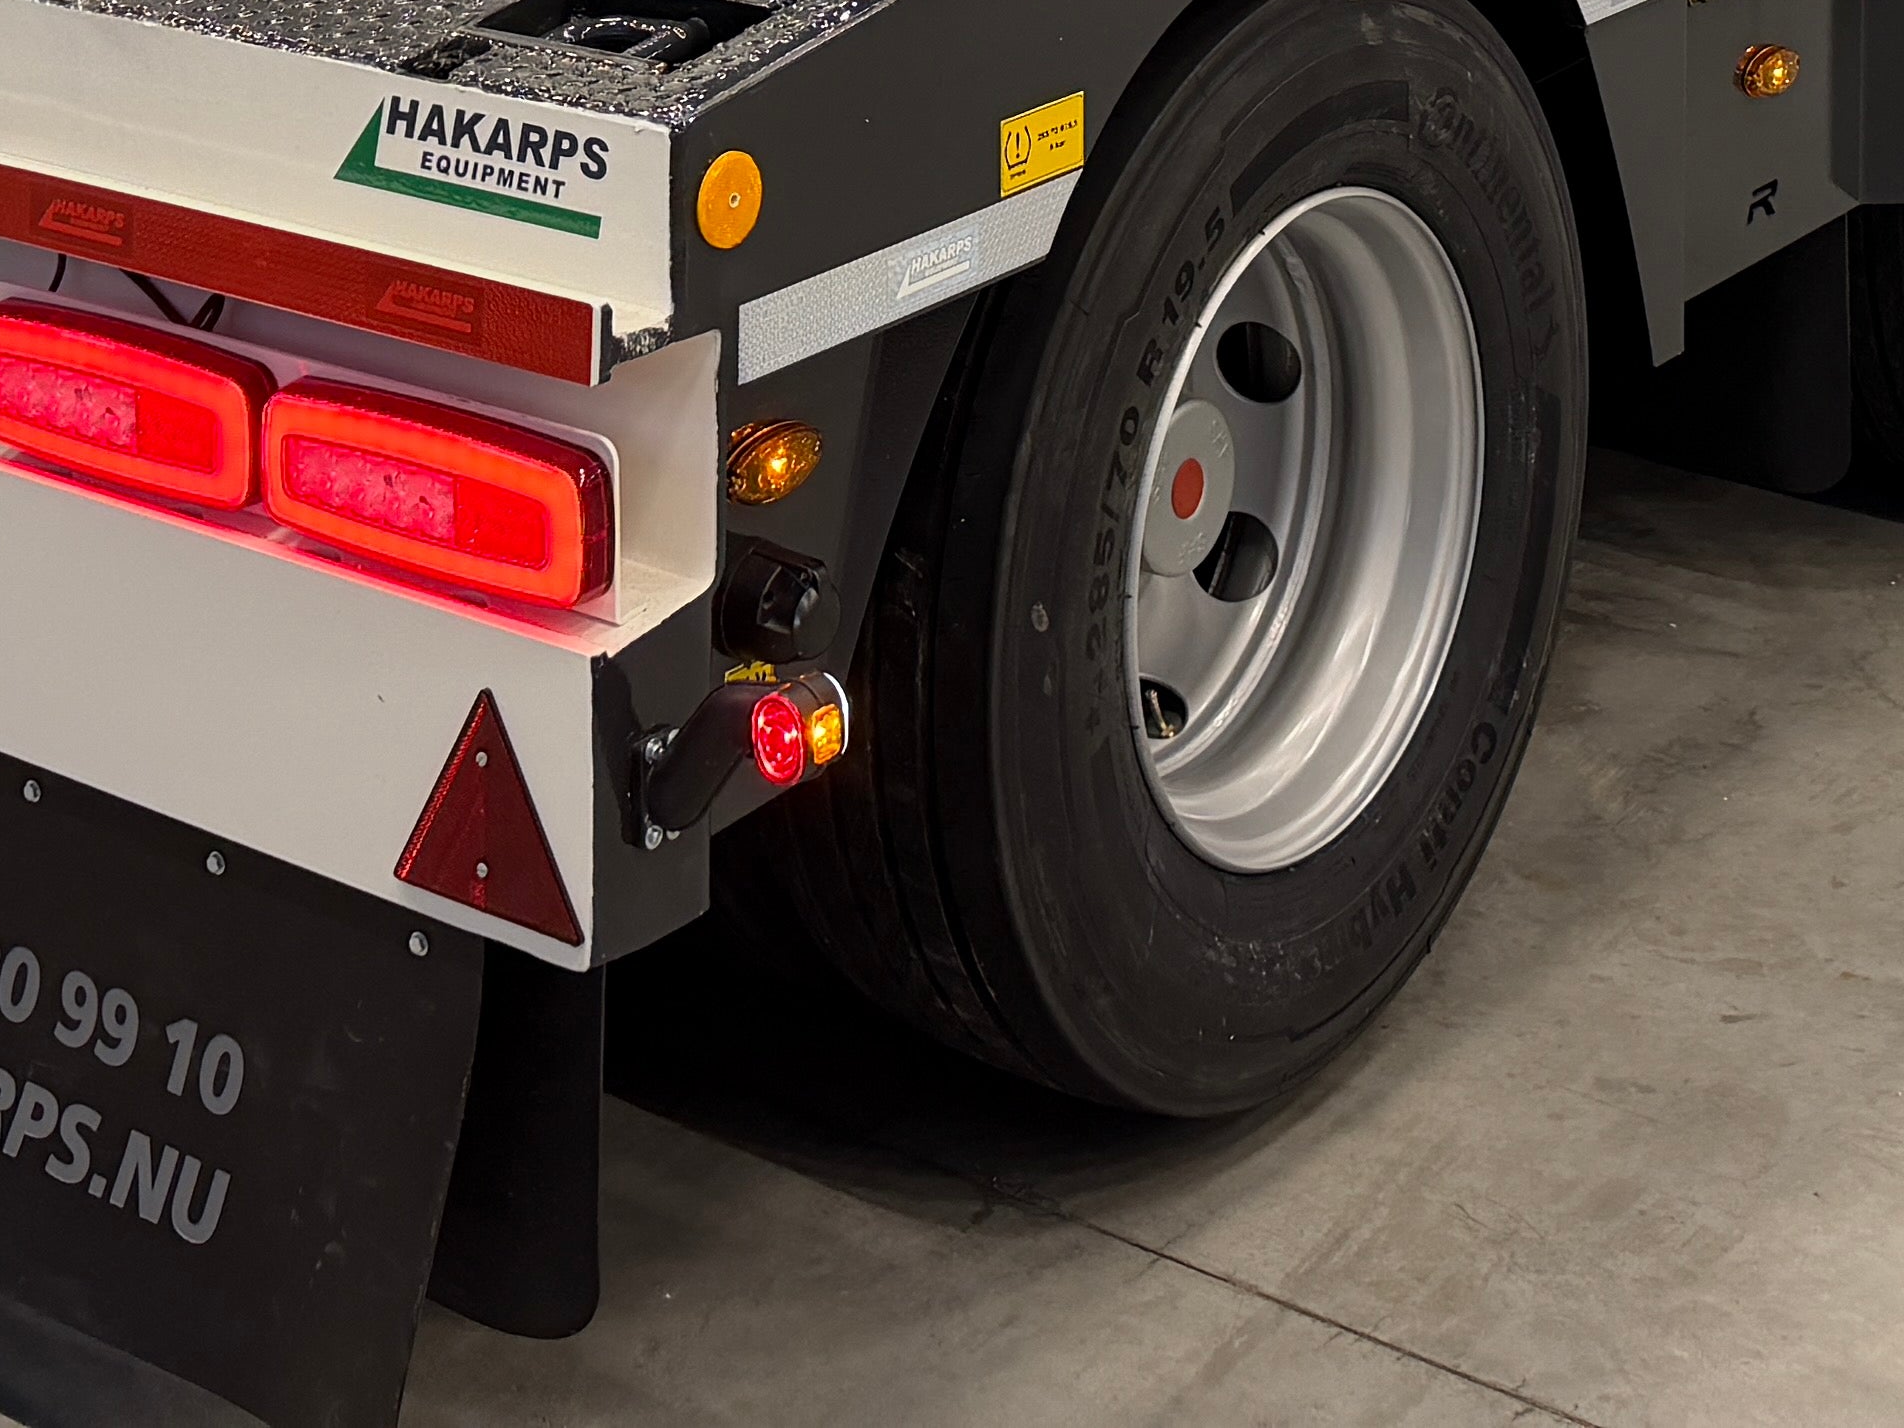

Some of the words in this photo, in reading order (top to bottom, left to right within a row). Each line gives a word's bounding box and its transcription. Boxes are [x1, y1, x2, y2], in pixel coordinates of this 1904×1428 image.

[385, 95, 610, 181] HAKARPS
[420, 150, 566, 199] EQUIPMENT
[52, 199, 126, 229] HAKARPS
[1746, 178, 1778, 226] R
[911, 236, 973, 275] HAKARPS
[395, 280, 475, 314] HAKARPS
[53, 970, 140, 1067] 99
[164, 1017, 245, 1115] 10
